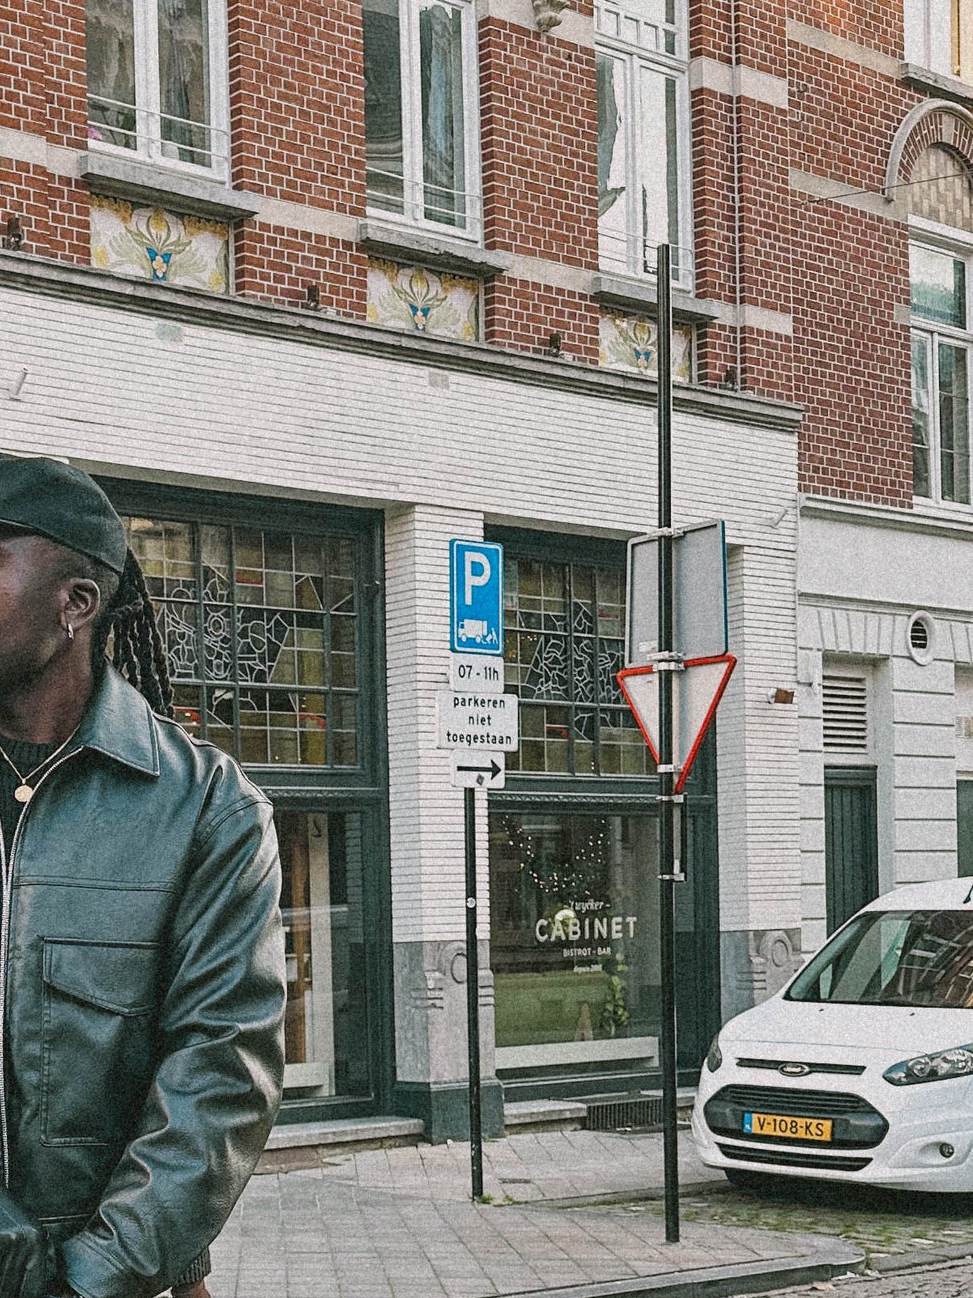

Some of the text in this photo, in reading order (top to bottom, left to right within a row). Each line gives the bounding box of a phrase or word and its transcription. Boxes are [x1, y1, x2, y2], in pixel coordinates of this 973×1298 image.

[464, 551, 491, 606] P
[458, 664, 472, 679] 07
[484, 666, 499, 681] 11h
[453, 696, 505, 709] parkeren
[468, 714, 492, 726] niet
[446, 730, 512, 747] toegestaan
[535, 916, 637, 942] CABINET
[562, 947, 591, 957] BISTROT
[597, 946, 611, 956] BAR
[757, 1116, 824, 1137] V-108-KS
